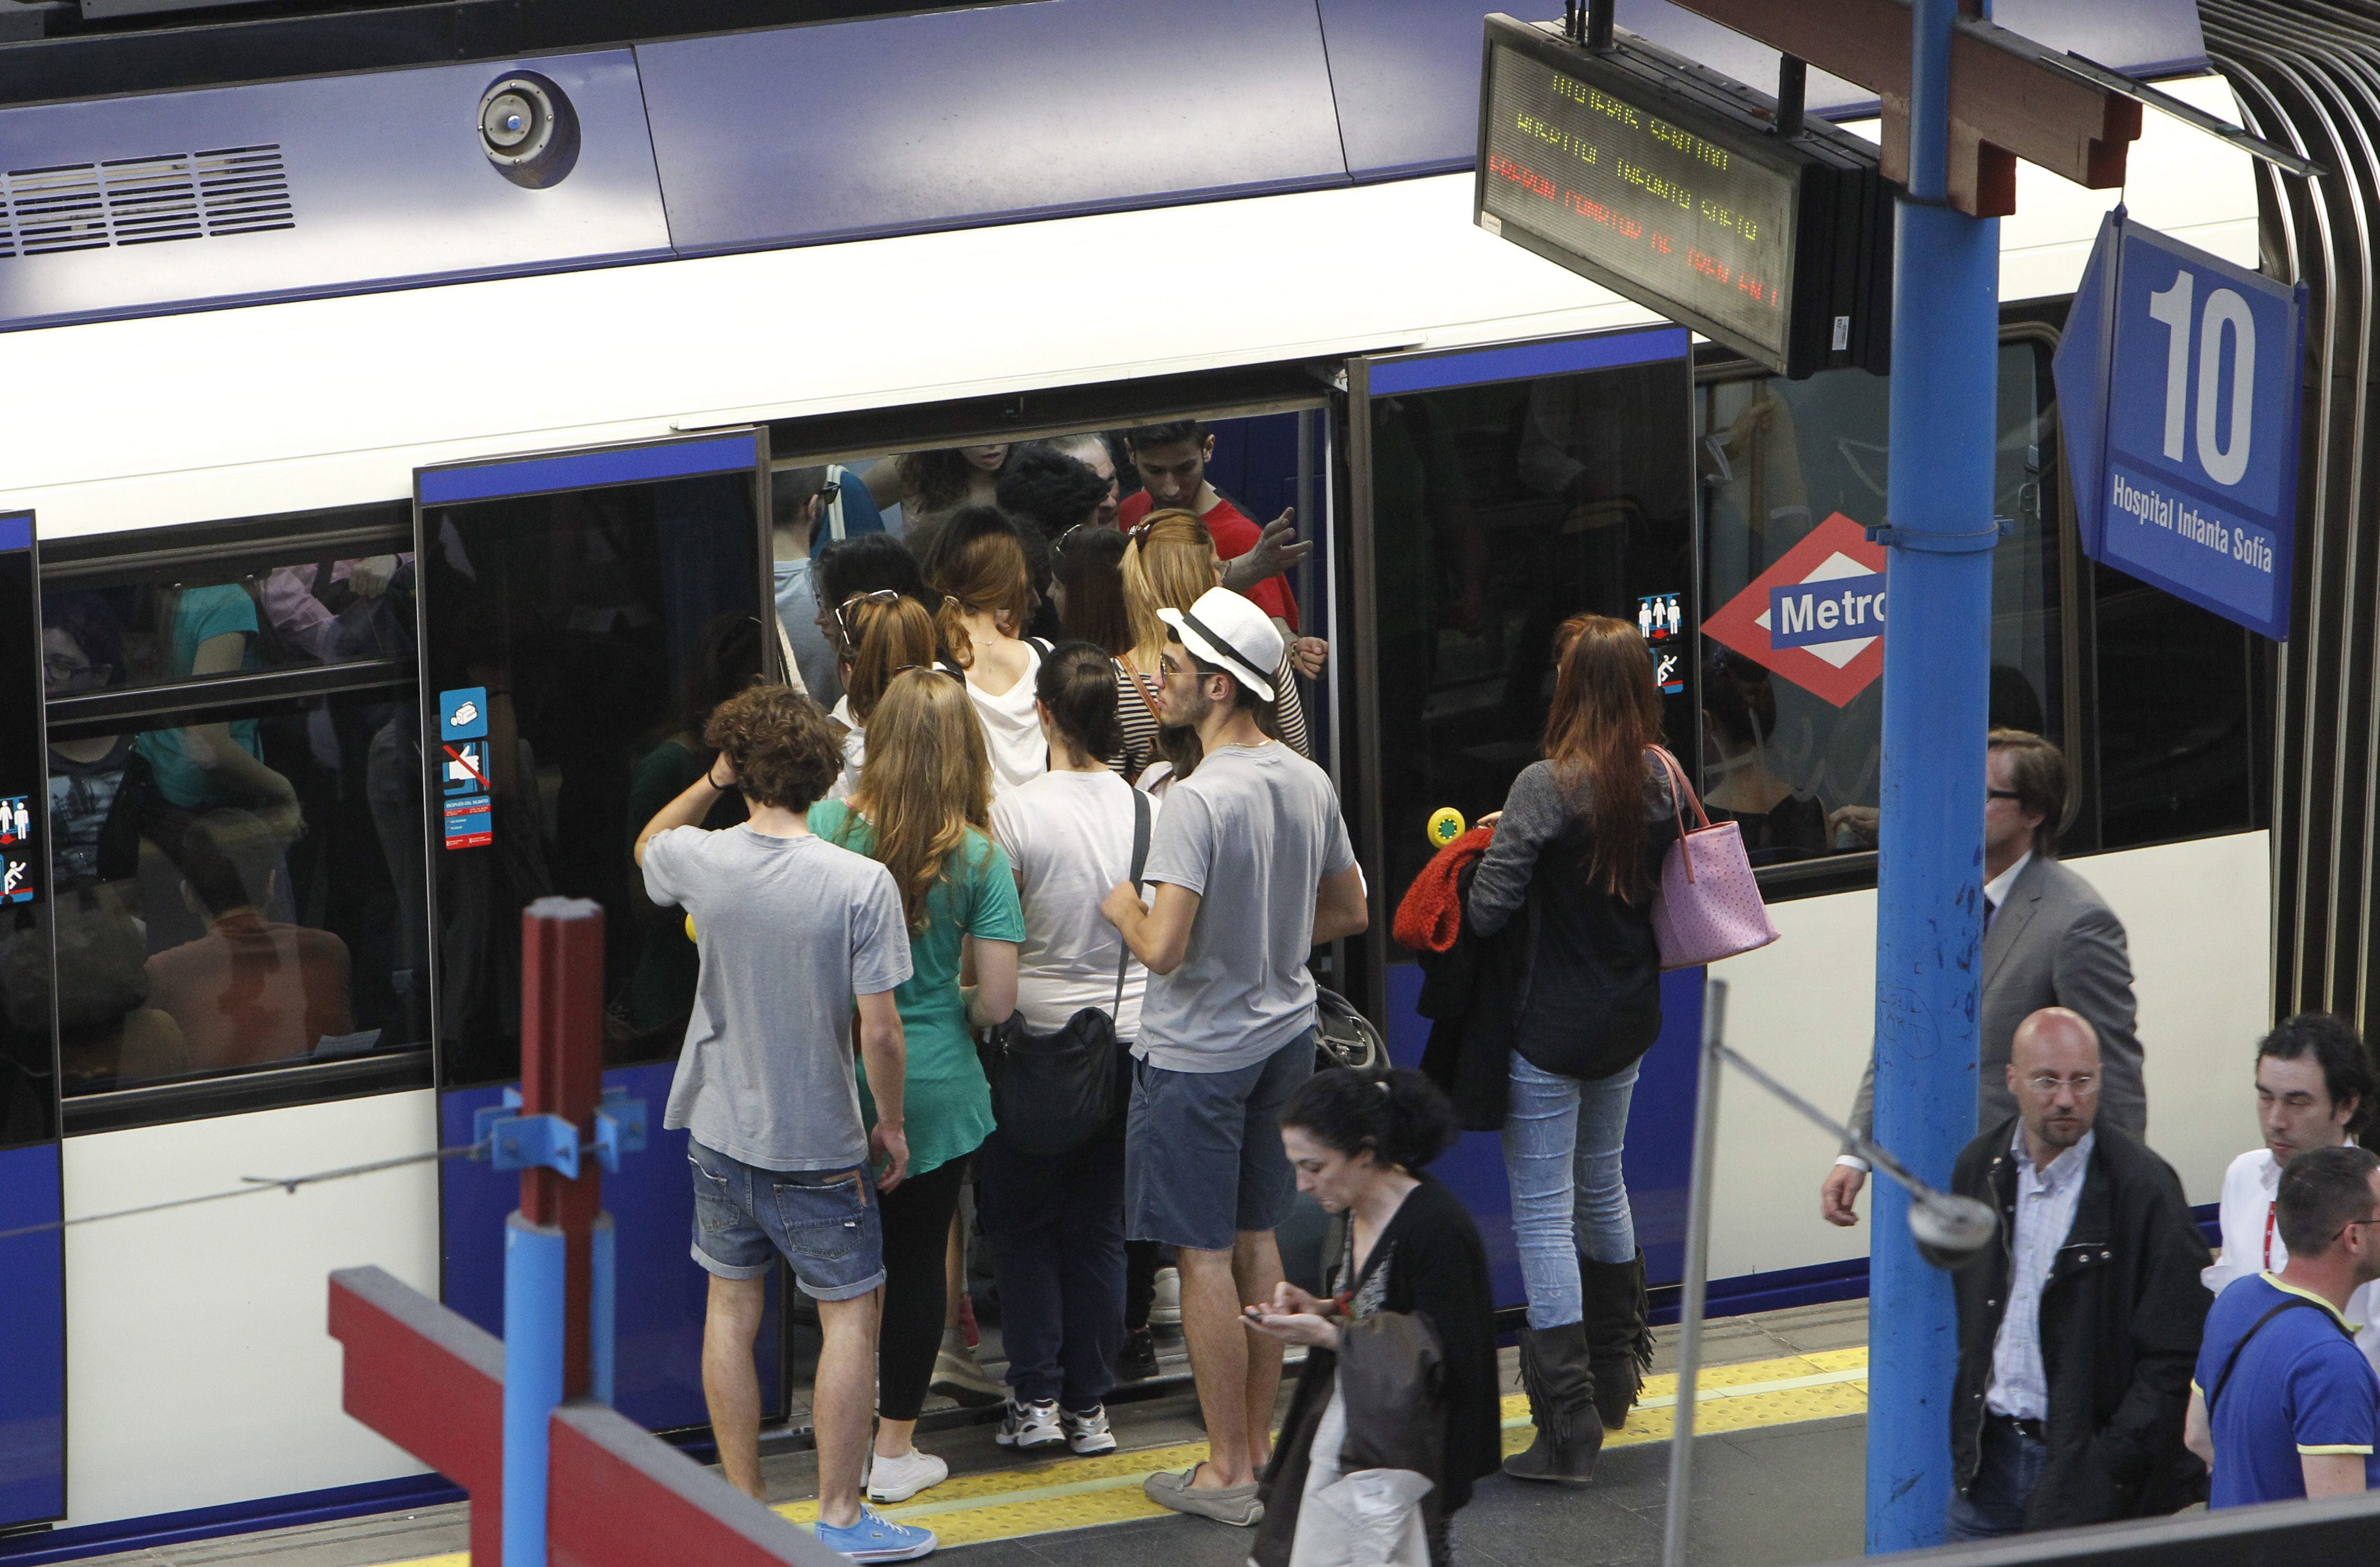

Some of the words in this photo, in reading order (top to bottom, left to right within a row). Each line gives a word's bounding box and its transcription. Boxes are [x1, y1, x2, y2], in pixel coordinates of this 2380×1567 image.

[2149, 269, 2257, 487] 10
[2113, 473, 2174, 530] Hospital
[2178, 502, 2229, 555] Infanta
[2232, 528, 2273, 574] Sofía
